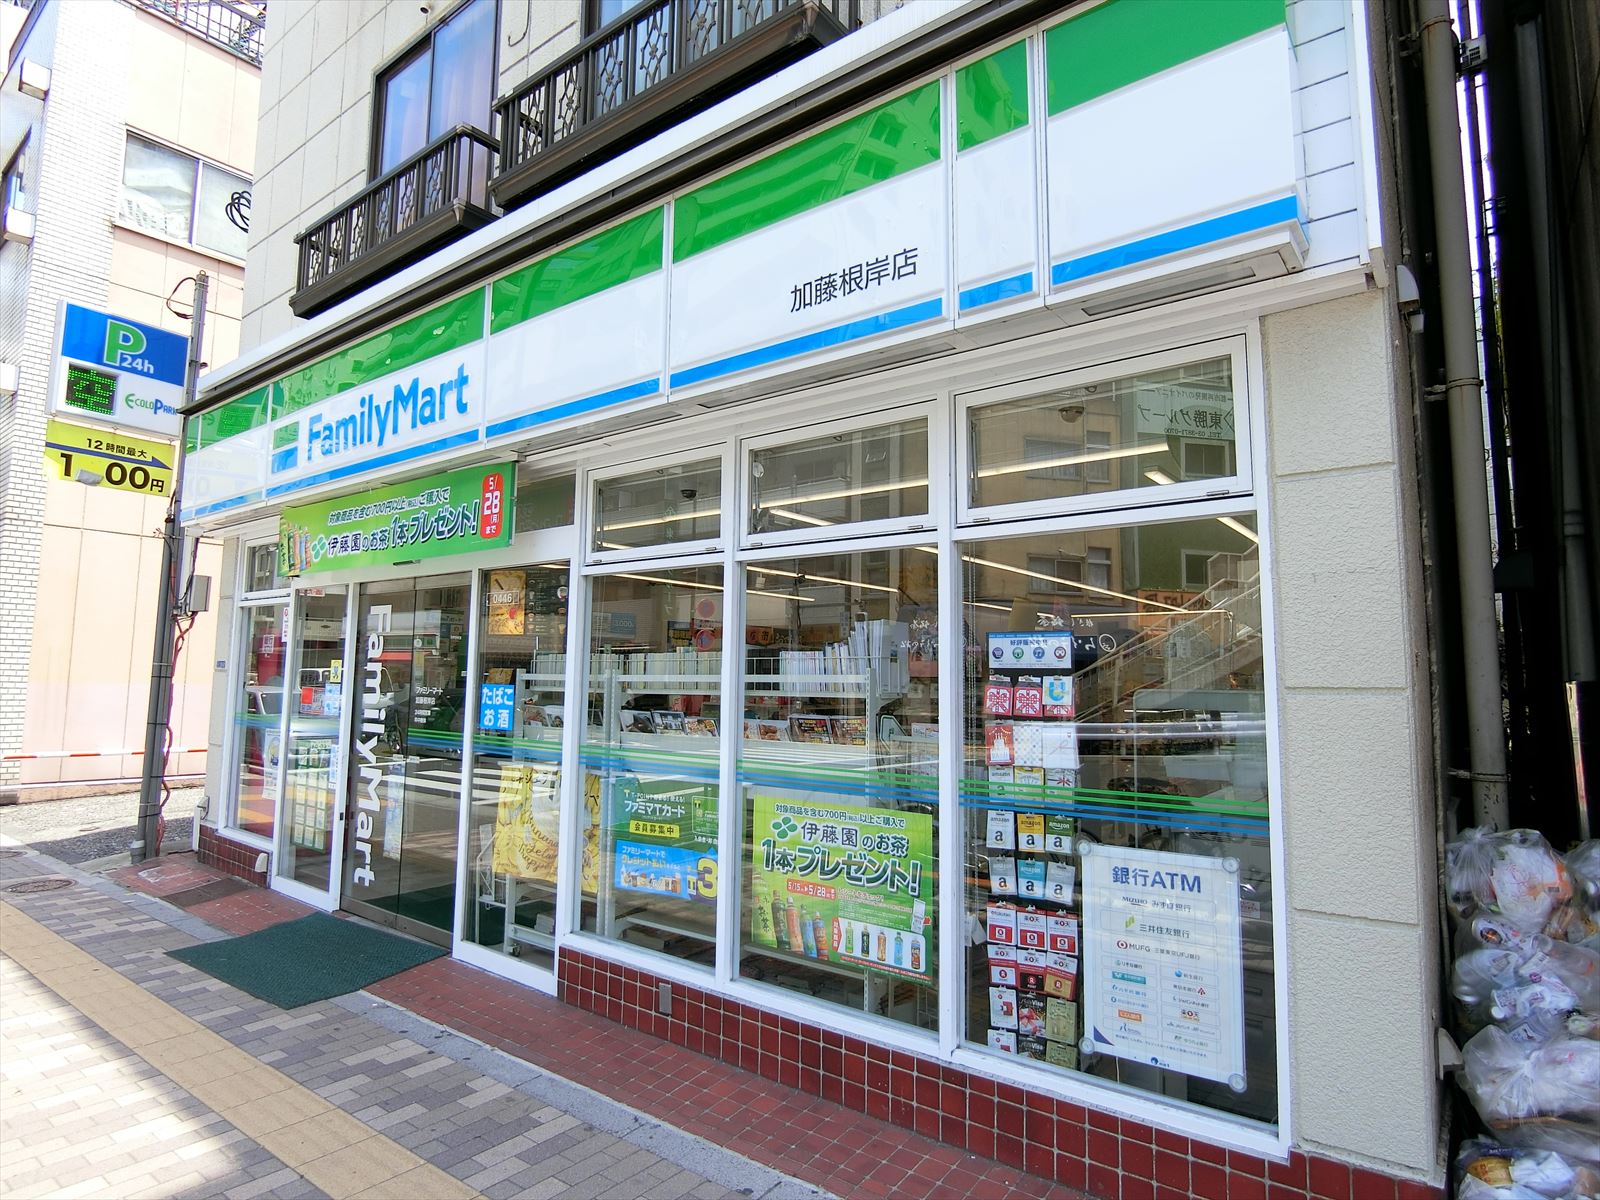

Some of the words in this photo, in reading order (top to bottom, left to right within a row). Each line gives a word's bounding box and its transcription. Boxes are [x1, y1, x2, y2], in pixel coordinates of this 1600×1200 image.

[791, 247, 918, 313] 加藤根岸店
[103, 318, 147, 367] P
[121, 354, 154, 374] 24h
[307, 362, 469, 462] FamilyMart
[86, 438, 147, 458] 12時間最大
[60, 452, 165, 493] 100円
[484, 491, 501, 515] 28
[485, 525, 497, 535] まで
[482, 686, 514, 706] たばこ
[483, 708, 510, 728] お酒
[354, 604, 393, 887] FamilyMart
[624, 800, 686, 818] ファミマTカード
[634, 822, 675, 835] 会員募集中
[1048, 821, 1070, 830] amazon
[801, 821, 909, 857] 伊藤園のお茶
[994, 830, 1004, 842] a
[1026, 834, 1035, 846] a
[1053, 836, 1063, 848] a
[761, 838, 922, 897] 1本プレゼント!
[1025, 880, 1035, 892] a
[1053, 883, 1063, 895] a
[1112, 866, 1202, 893] 銀行ATM
[1139, 923, 1190, 939] 三井住友銀行
